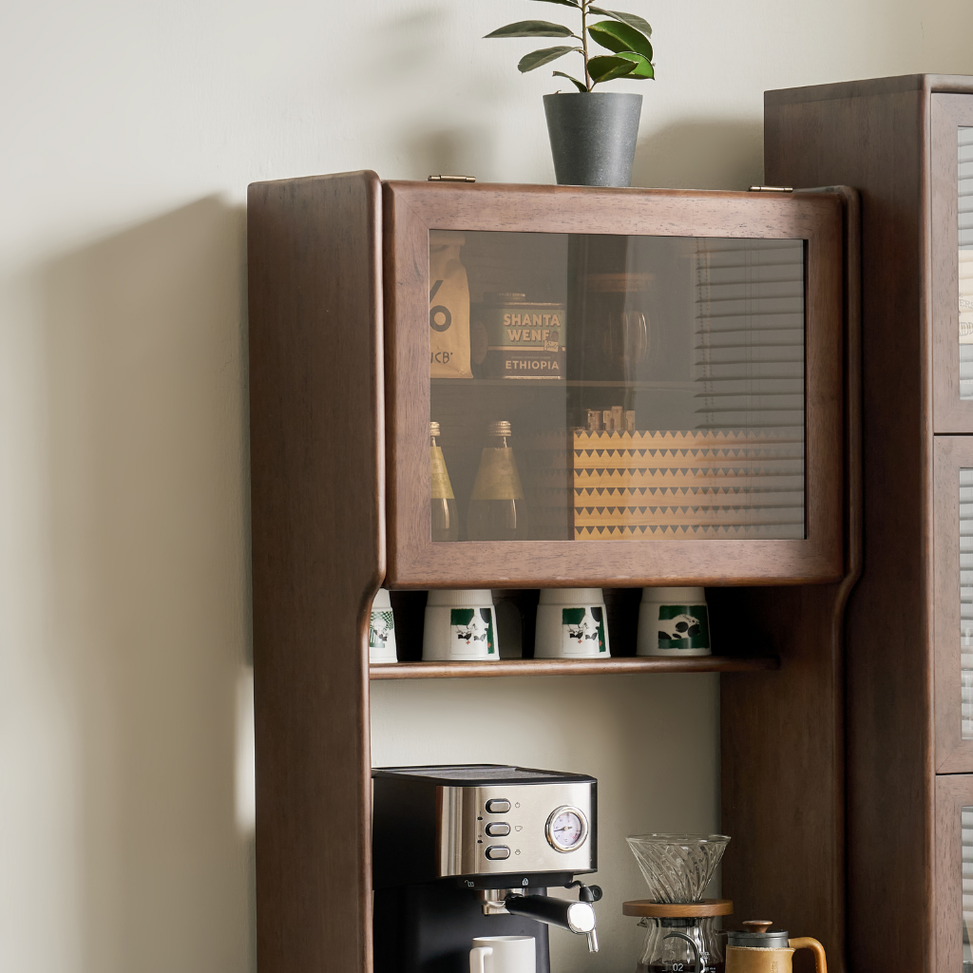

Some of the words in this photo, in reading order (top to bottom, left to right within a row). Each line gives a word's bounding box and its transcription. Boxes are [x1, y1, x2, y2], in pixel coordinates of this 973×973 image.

[503, 314, 561, 327] SHANTA
[505, 361, 559, 370] ETHIOPIA
[672, 962, 684, 972] 02
